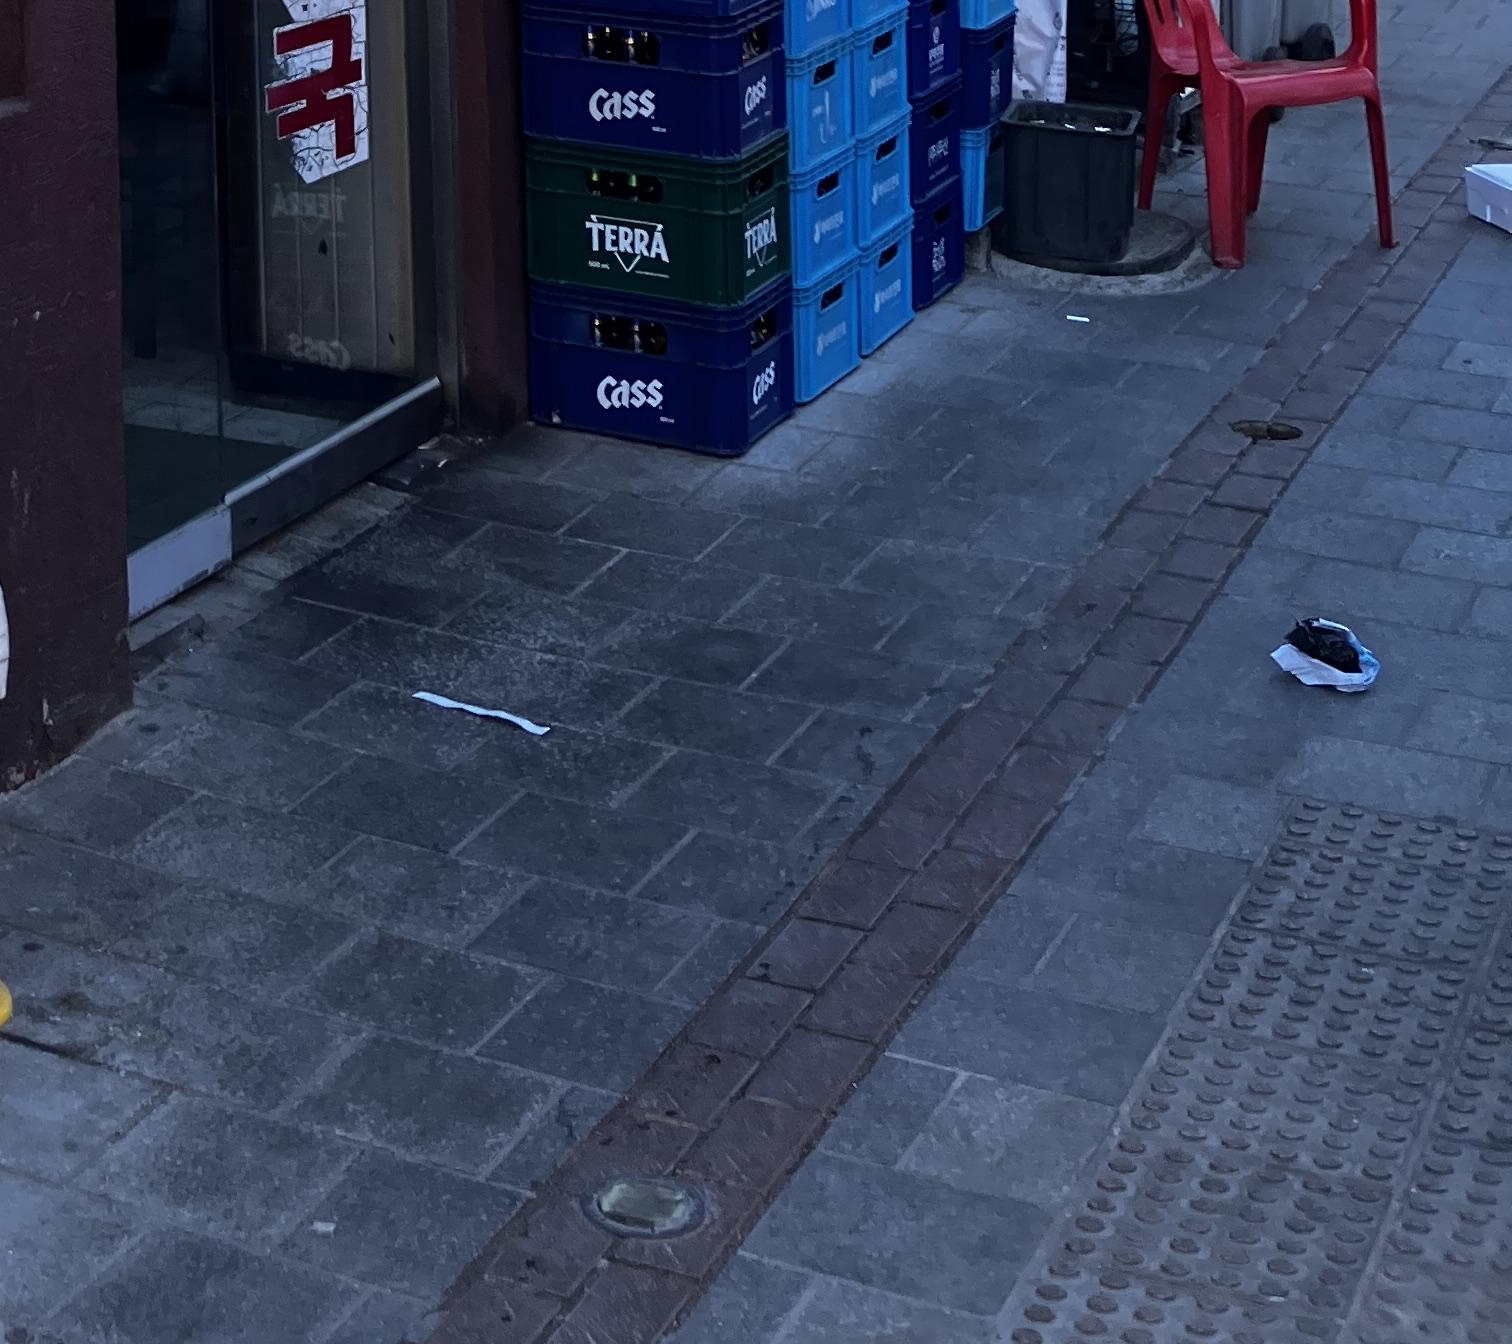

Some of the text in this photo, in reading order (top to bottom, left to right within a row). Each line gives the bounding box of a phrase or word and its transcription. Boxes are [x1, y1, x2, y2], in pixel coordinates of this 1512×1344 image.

[589, 88, 656, 122] Cass
[585, 220, 670, 264] TERRA
[744, 212, 778, 259] TERRA
[596, 375, 663, 410] Cass
